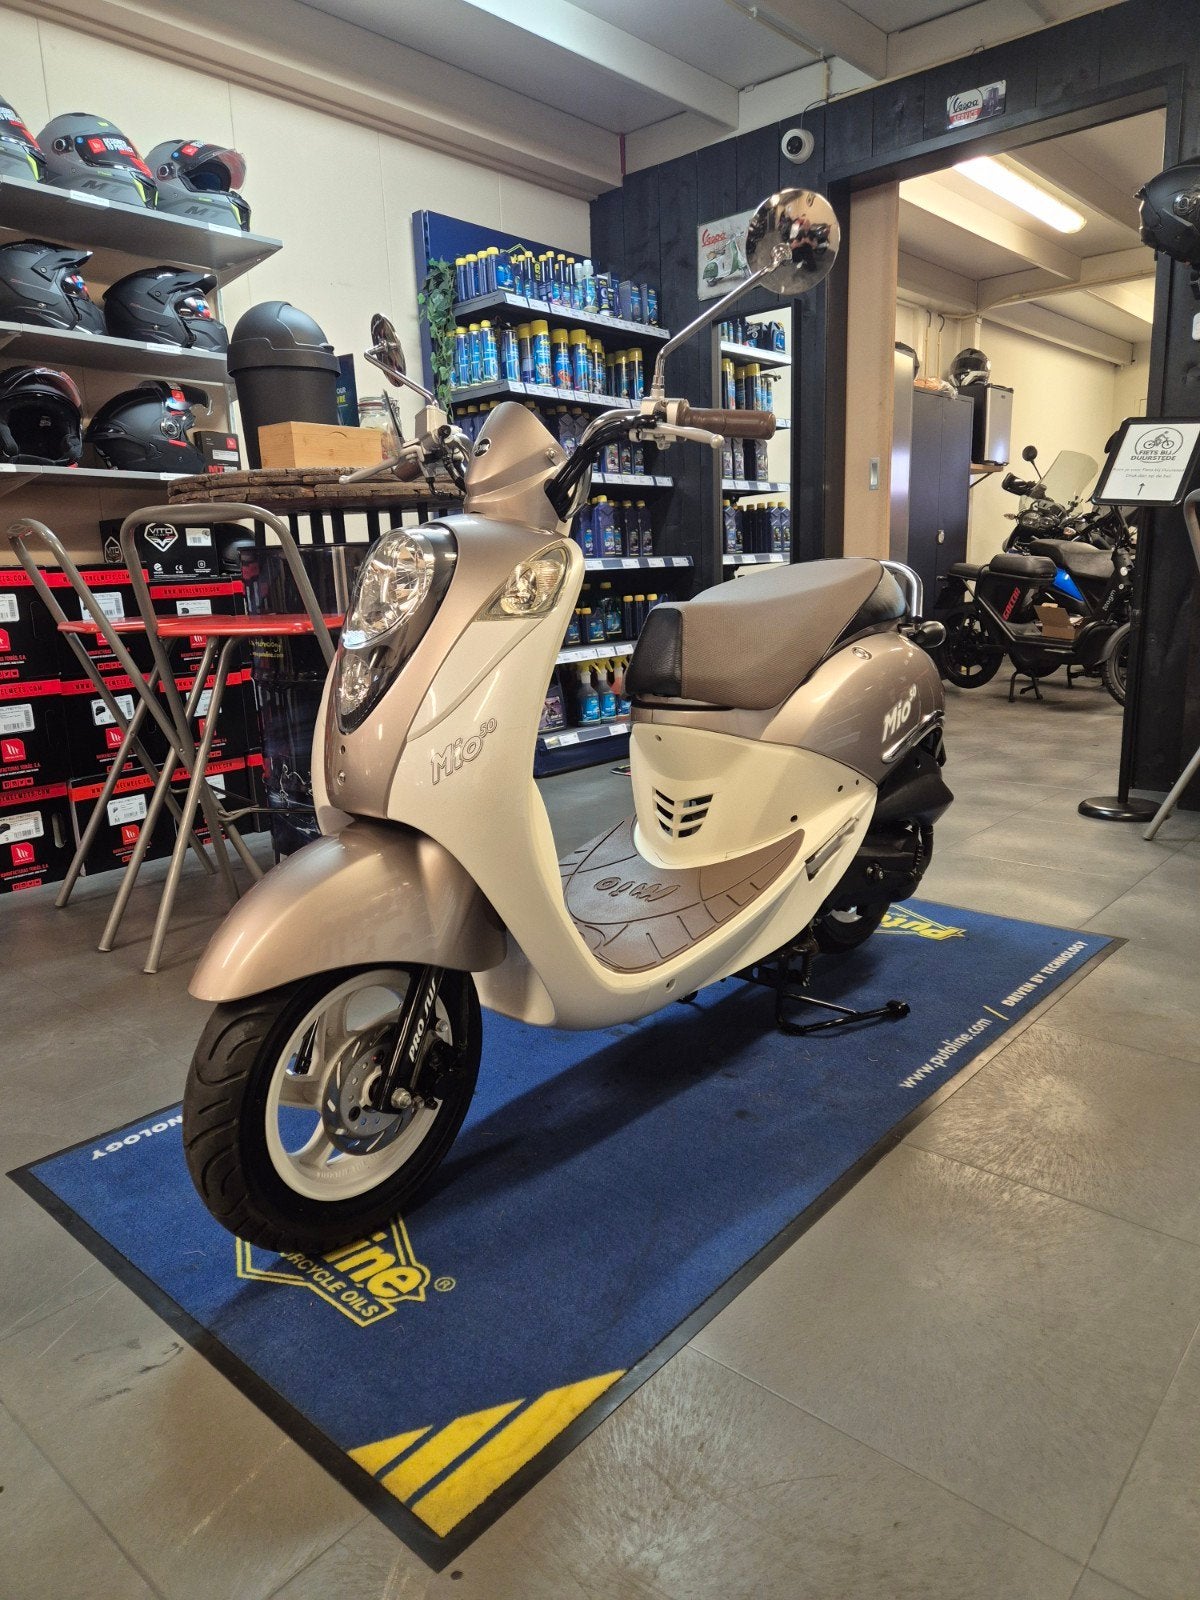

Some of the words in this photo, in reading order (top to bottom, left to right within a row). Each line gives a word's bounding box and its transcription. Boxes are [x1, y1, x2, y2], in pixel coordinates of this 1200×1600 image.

[702, 229, 728, 248] Vespa
[882, 699, 911, 743] Mio
[431, 735, 483, 786] Mio
[899, 1017, 993, 1090] www.putoline.com
[1001, 982, 1037, 1007] DRIVEN
[1029, 973, 1048, 984] BY
[1040, 940, 1089, 975] TECHNOLOGY
[408, 1018, 424, 1063] PRO
[92, 1115, 183, 1161] NOLOGY
[280, 1250, 346, 1294] RCYCLE
[340, 1290, 380, 1317] OILS
